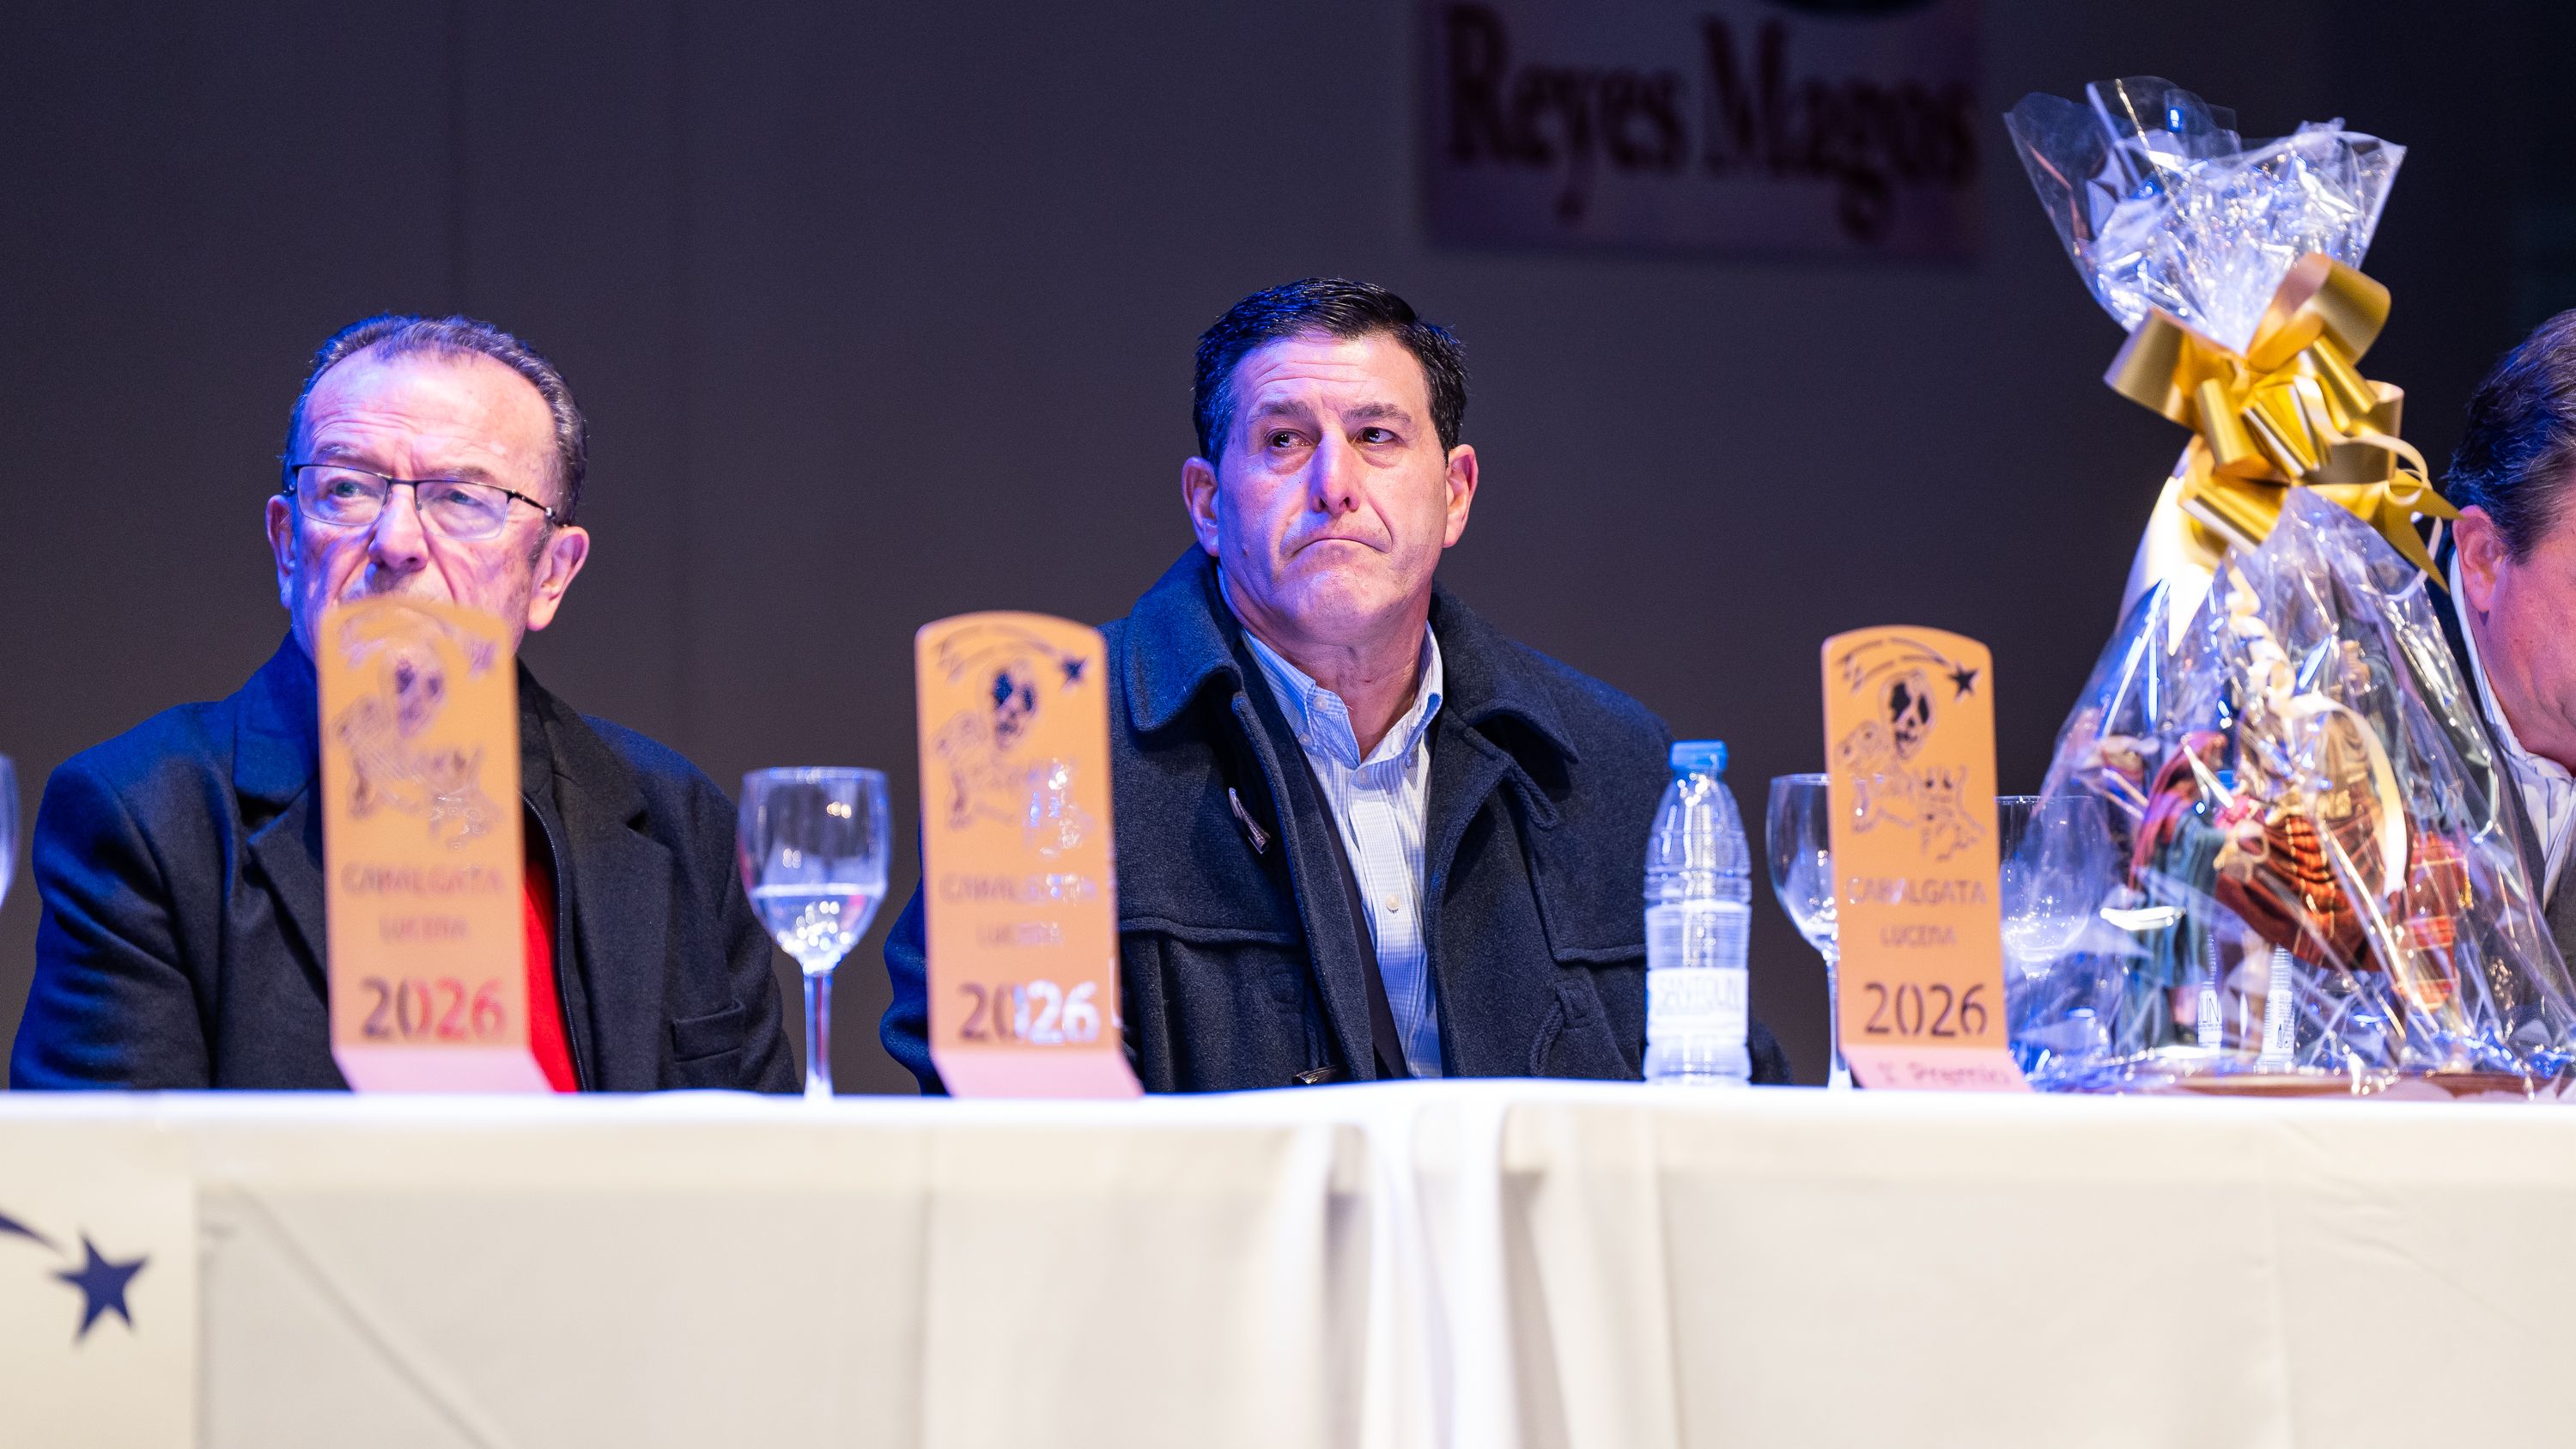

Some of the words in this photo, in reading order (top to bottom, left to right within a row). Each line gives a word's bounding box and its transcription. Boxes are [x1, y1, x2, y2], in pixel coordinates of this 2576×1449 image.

[1447, 3, 1687, 223] Reyes
[1698, 15, 1978, 242] Magos
[361, 976, 504, 1038] 2026
[957, 980, 1098, 1043] 2026
[1863, 983, 1988, 1037] 2026
